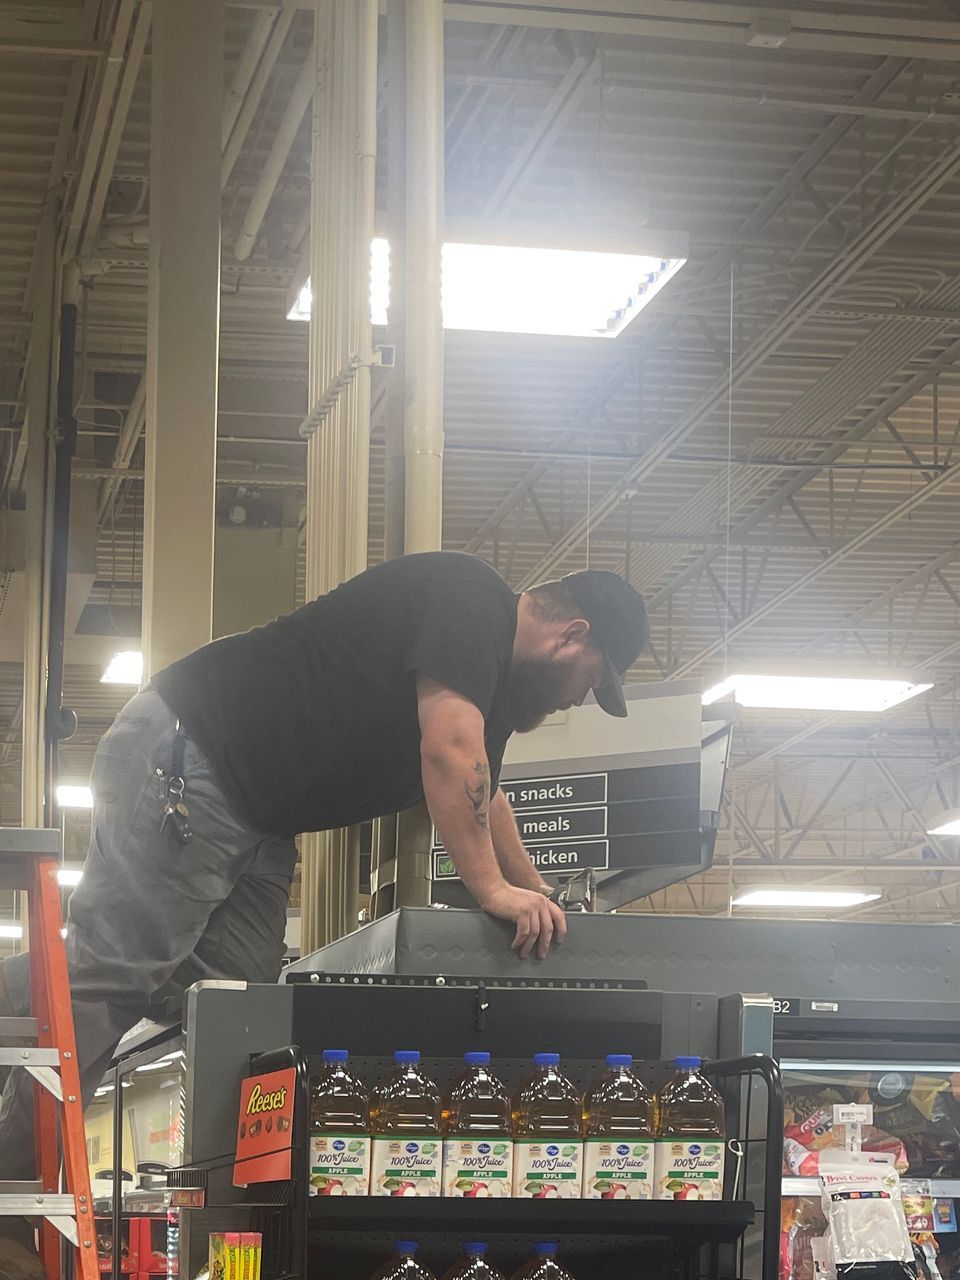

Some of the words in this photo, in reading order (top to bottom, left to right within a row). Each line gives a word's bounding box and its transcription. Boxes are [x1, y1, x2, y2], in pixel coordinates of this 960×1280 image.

[520, 784, 574, 802] snacks
[523, 816, 570, 834] meals
[529, 850, 578, 866] hicken
[246, 1083, 288, 1116] Reese's
